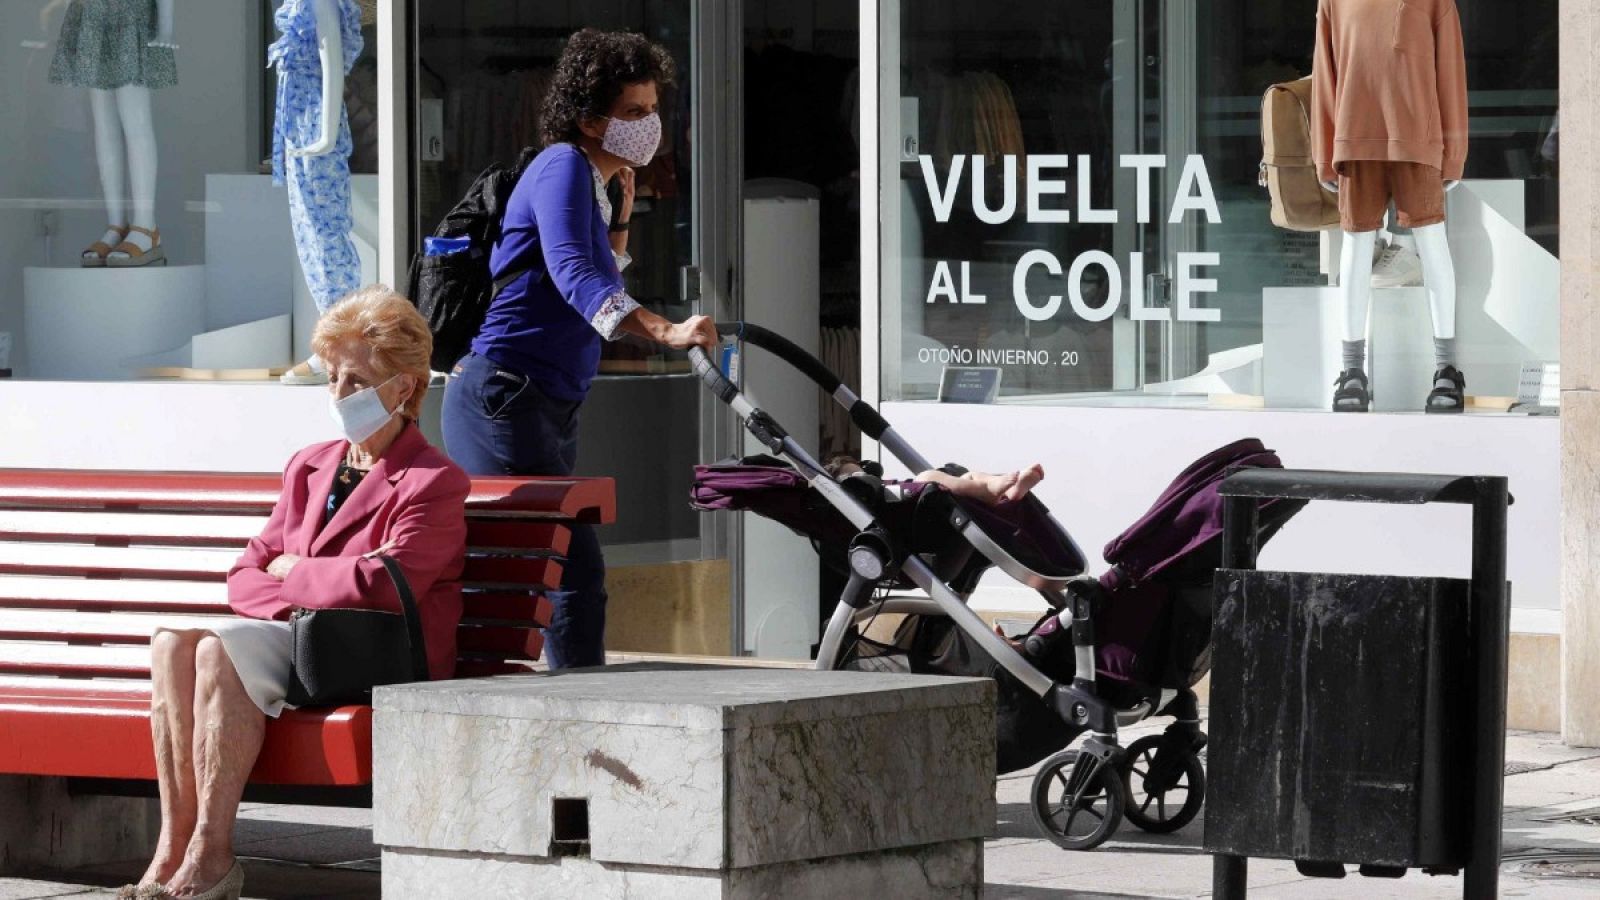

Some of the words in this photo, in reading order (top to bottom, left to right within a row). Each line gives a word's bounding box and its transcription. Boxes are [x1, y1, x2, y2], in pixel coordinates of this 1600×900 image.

[918, 154, 1222, 224] VUELTA
[926, 261, 987, 303] AL
[1012, 249, 1221, 322] COLE
[918, 345, 972, 363] OTOÑO
[976, 350, 1049, 365] INVIERNO
[1061, 351, 1079, 366] 20
